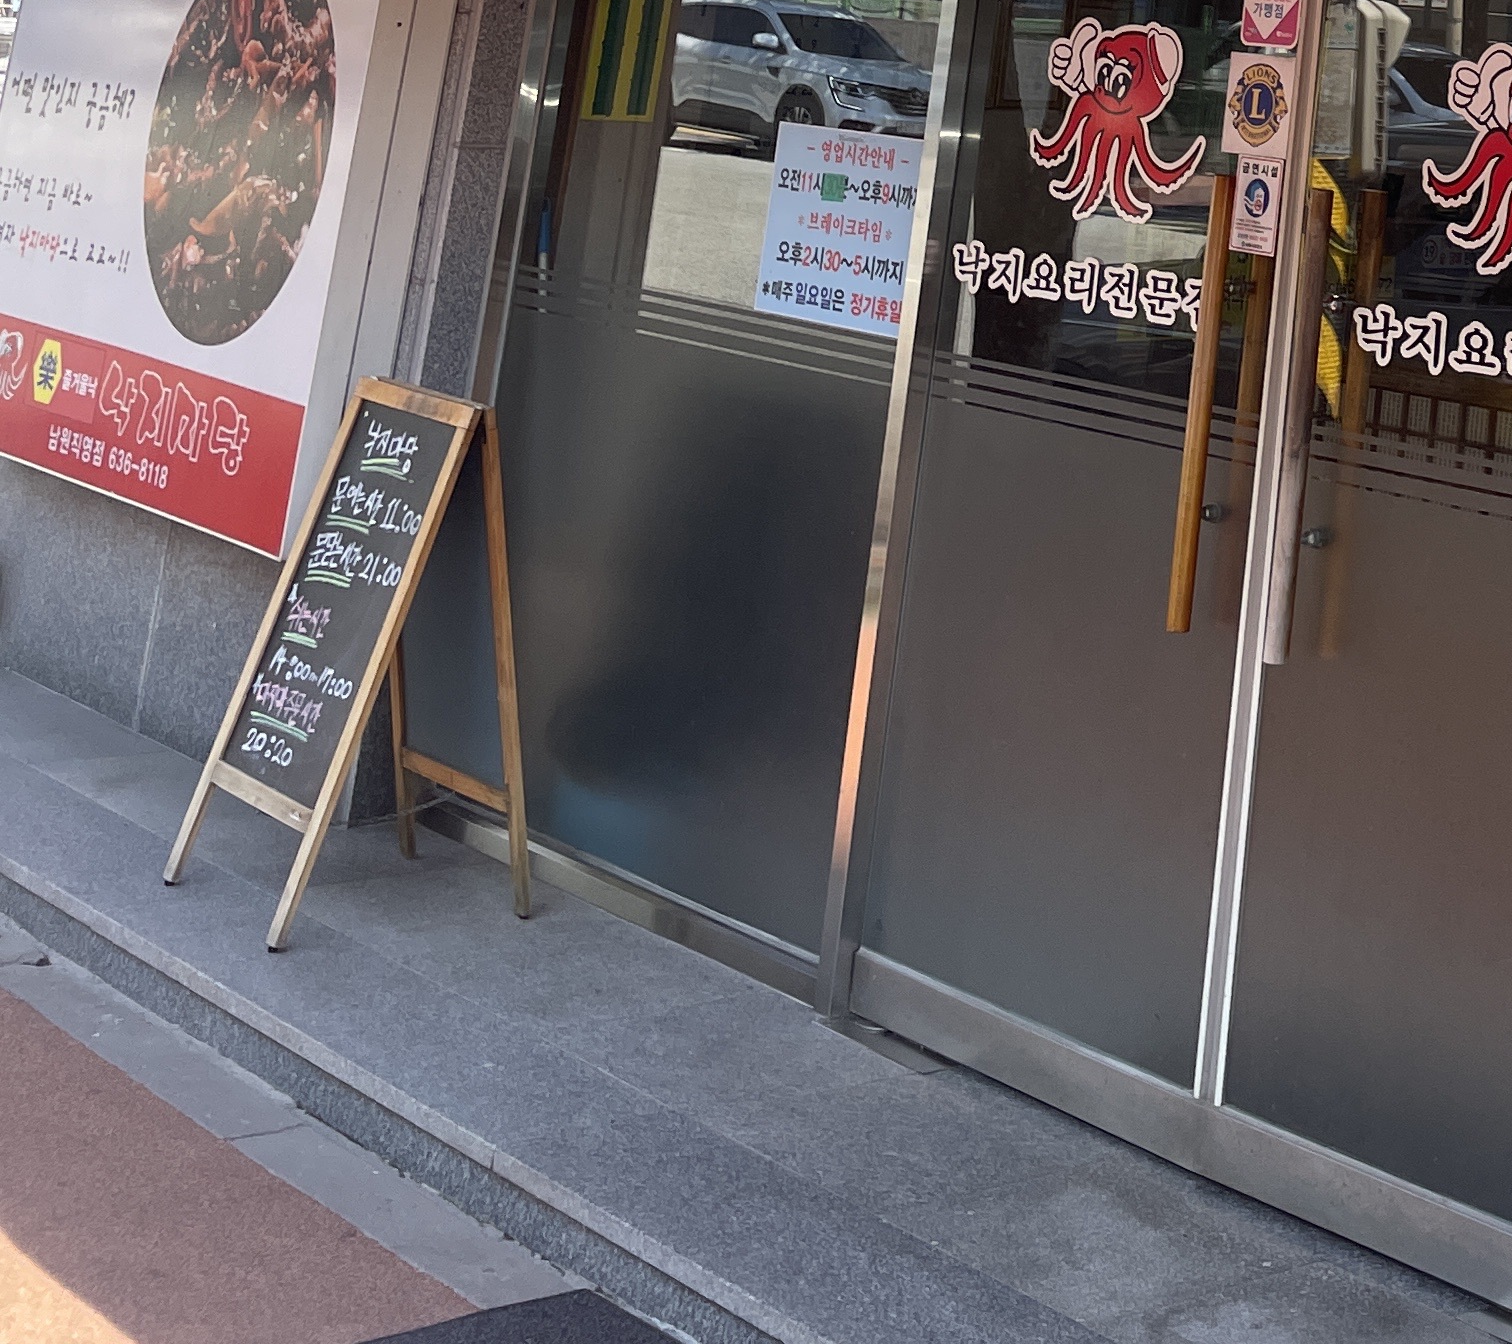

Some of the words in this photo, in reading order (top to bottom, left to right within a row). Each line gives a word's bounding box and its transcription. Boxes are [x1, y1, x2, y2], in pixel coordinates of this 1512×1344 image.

[1253, 3, 1283, 19] 가맹점
[1246, 67, 1277, 85] LIONS
[1251, 88, 1266, 119] L
[821, 140, 896, 172] 영업시간안내
[1242, 162, 1278, 178] 금연시설
[0, 167, 34, 203] 금하면
[807, 212, 883, 243] 브레이크타임
[850, 293, 902, 325] 정기휴일
[37, 350, 58, 391] 樂
[61, 368, 98, 399] 즐거울낙
[100, 361, 250, 476] 낙지마당
[48, 424, 105, 467] 남원직영점
[109, 446, 168, 489] 636-8118
[364, 419, 419, 473] 낙지마당
[380, 498, 422, 535] 11:00
[359, 552, 402, 587] 21:00
[241, 727, 293, 767] 20:20
